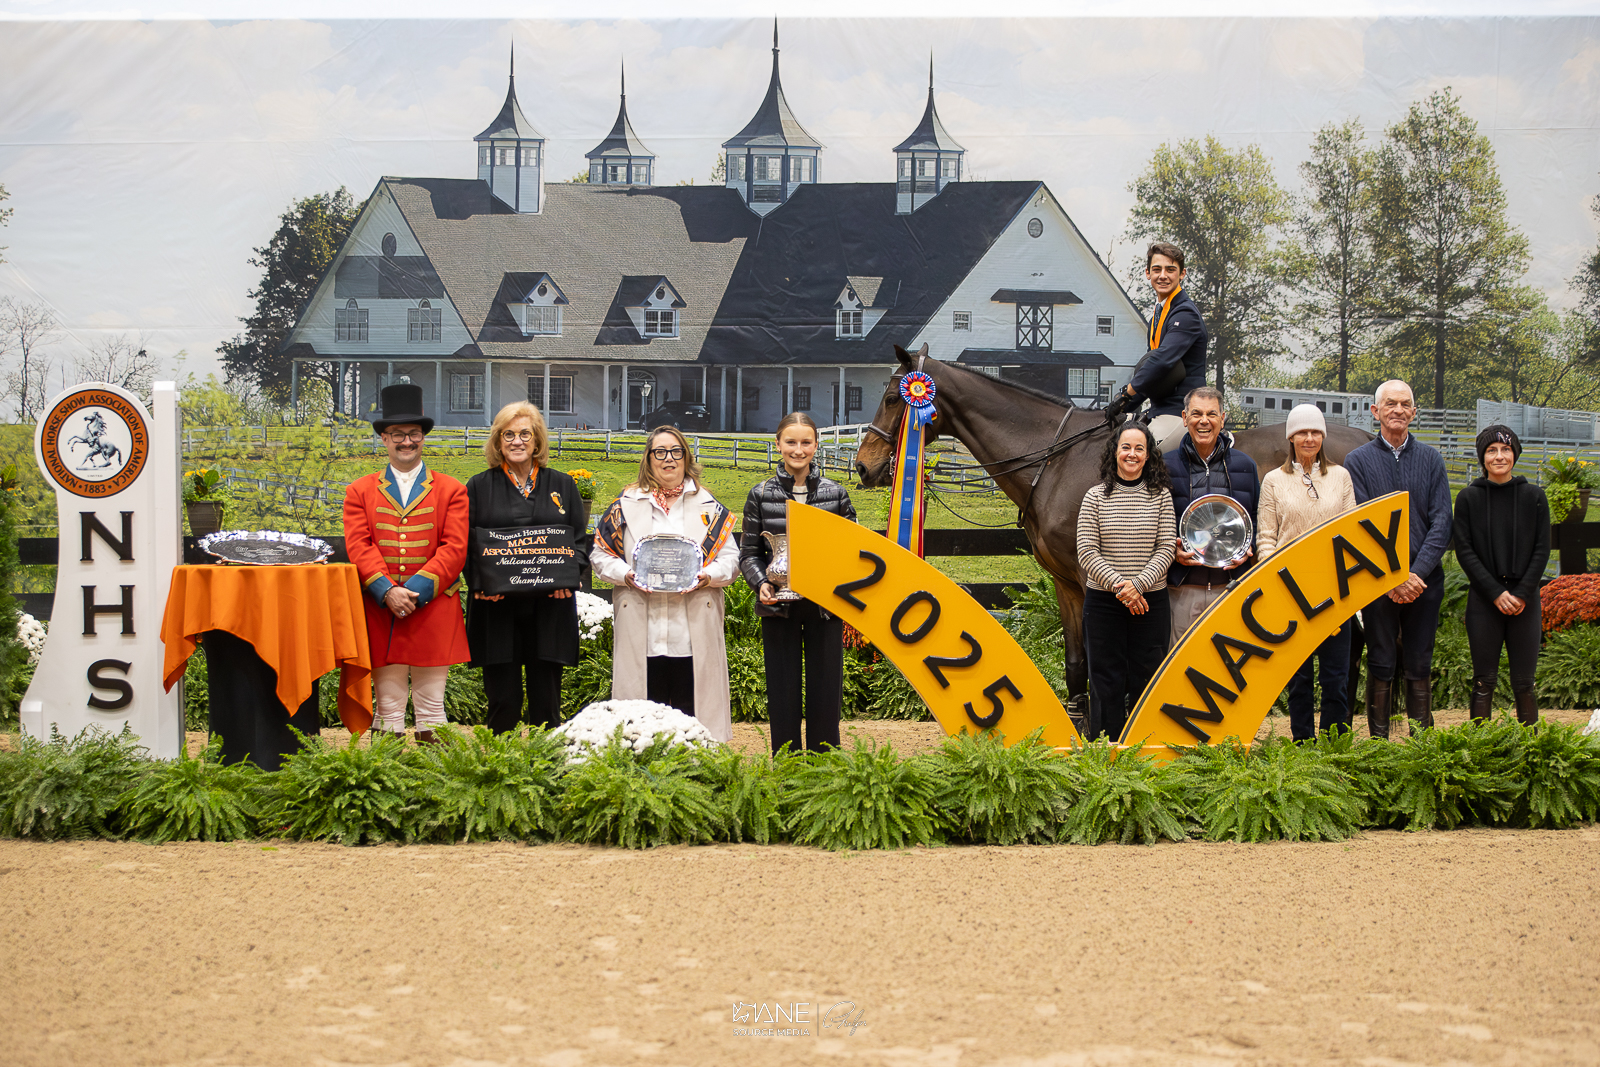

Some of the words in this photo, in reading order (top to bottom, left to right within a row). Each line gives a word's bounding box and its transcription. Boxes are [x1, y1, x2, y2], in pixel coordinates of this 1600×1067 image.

[60, 395, 86, 417] SHOW
[89, 394, 141, 431] ASSOCIATION
[46, 414, 63, 446] HORSE
[134, 432, 144, 446] OF
[47, 447, 78, 488] NATIONAL
[112, 447, 143, 487] AMERICA
[84, 484, 106, 494] 1883
[482, 547, 514, 557] ASPCA
[513, 545, 575, 557] Horsemanship
[507, 535, 548, 548] MACLAY
[496, 556, 535, 566] National
[536, 555, 565, 565] Finals
[509, 575, 554, 587] Champion
[1160, 508, 1403, 744] MACLAY
[832, 549, 1024, 728] 2025
